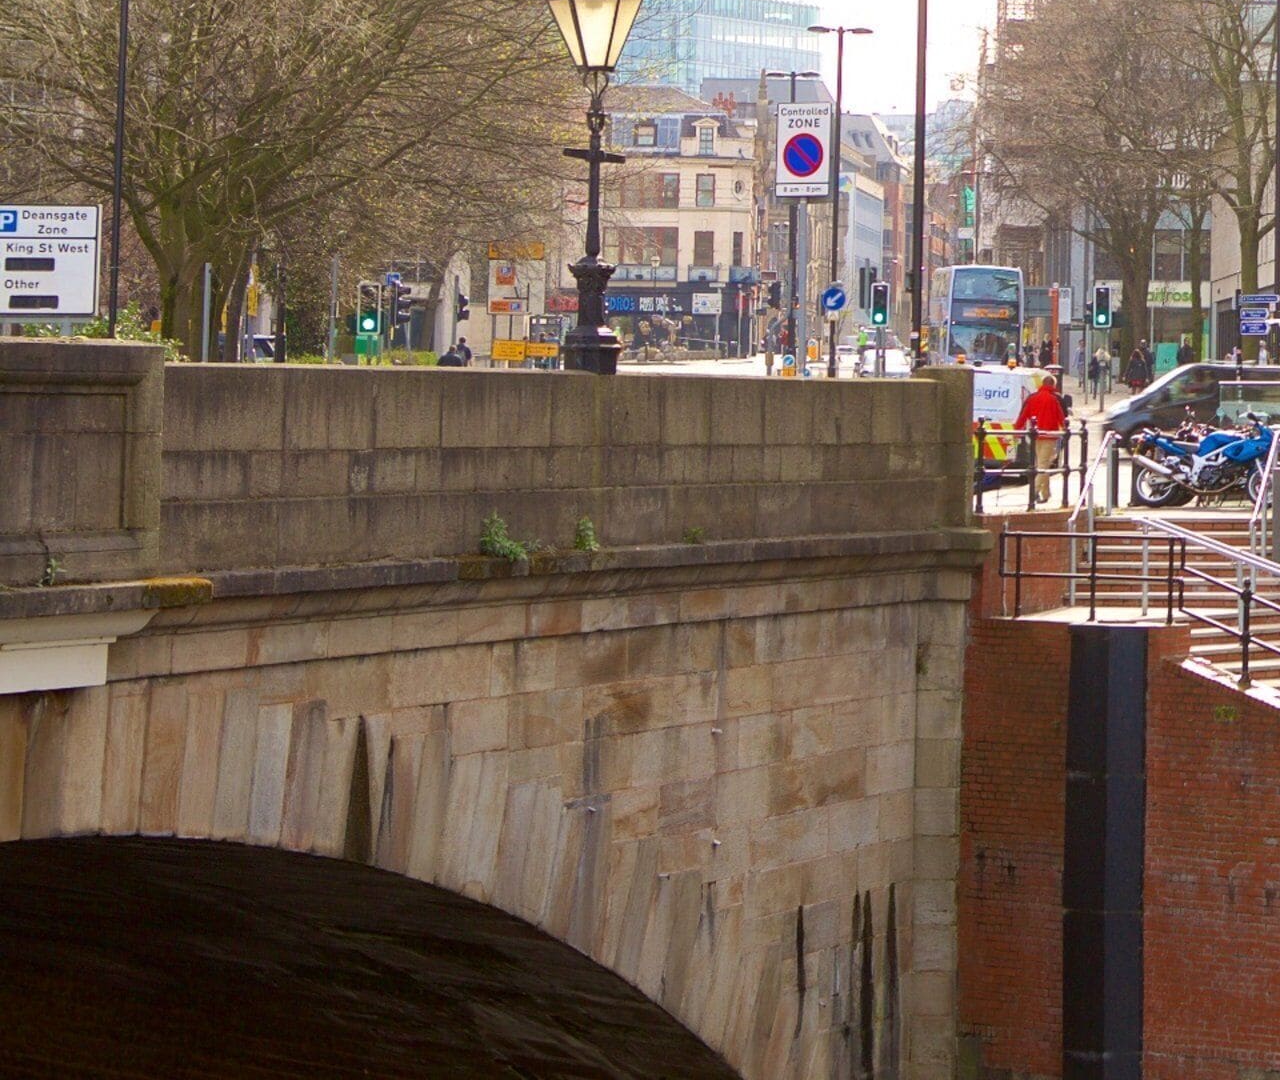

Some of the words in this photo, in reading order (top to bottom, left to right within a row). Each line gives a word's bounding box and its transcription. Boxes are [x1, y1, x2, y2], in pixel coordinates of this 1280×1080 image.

[781, 107, 829, 116] Controlled
[788, 118, 821, 128] ZONE
[22, 210, 88, 222] Deansgate
[38, 224, 68, 235] Zone
[6, 243, 33, 255] King
[38, 243, 53, 253] St
[58, 243, 89, 253] West
[4, 279, 40, 289] Other
